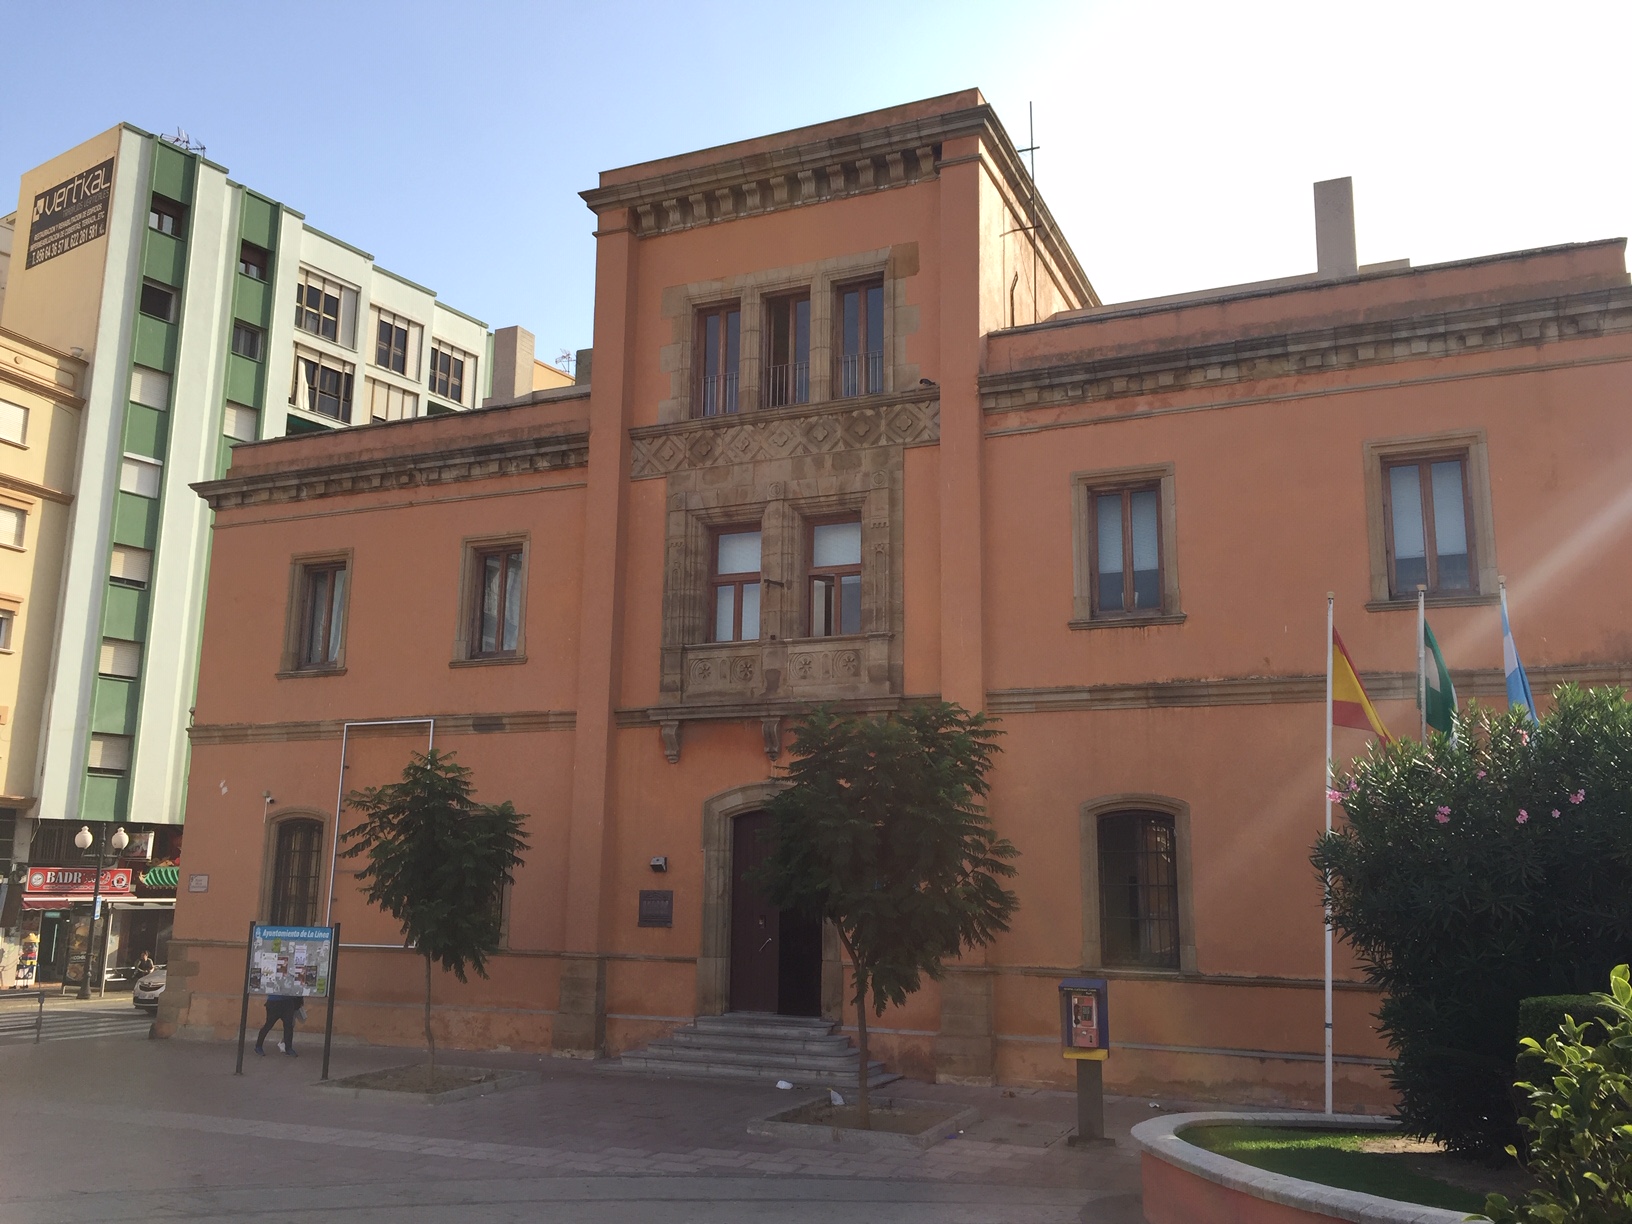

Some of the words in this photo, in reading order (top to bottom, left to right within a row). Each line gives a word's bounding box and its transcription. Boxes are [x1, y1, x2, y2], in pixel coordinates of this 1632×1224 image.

[46, 871, 82, 884] BADR
[263, 929, 300, 938] Ayuntamiento
[300, 929, 307, 937] de
[307, 930, 315, 938] La
